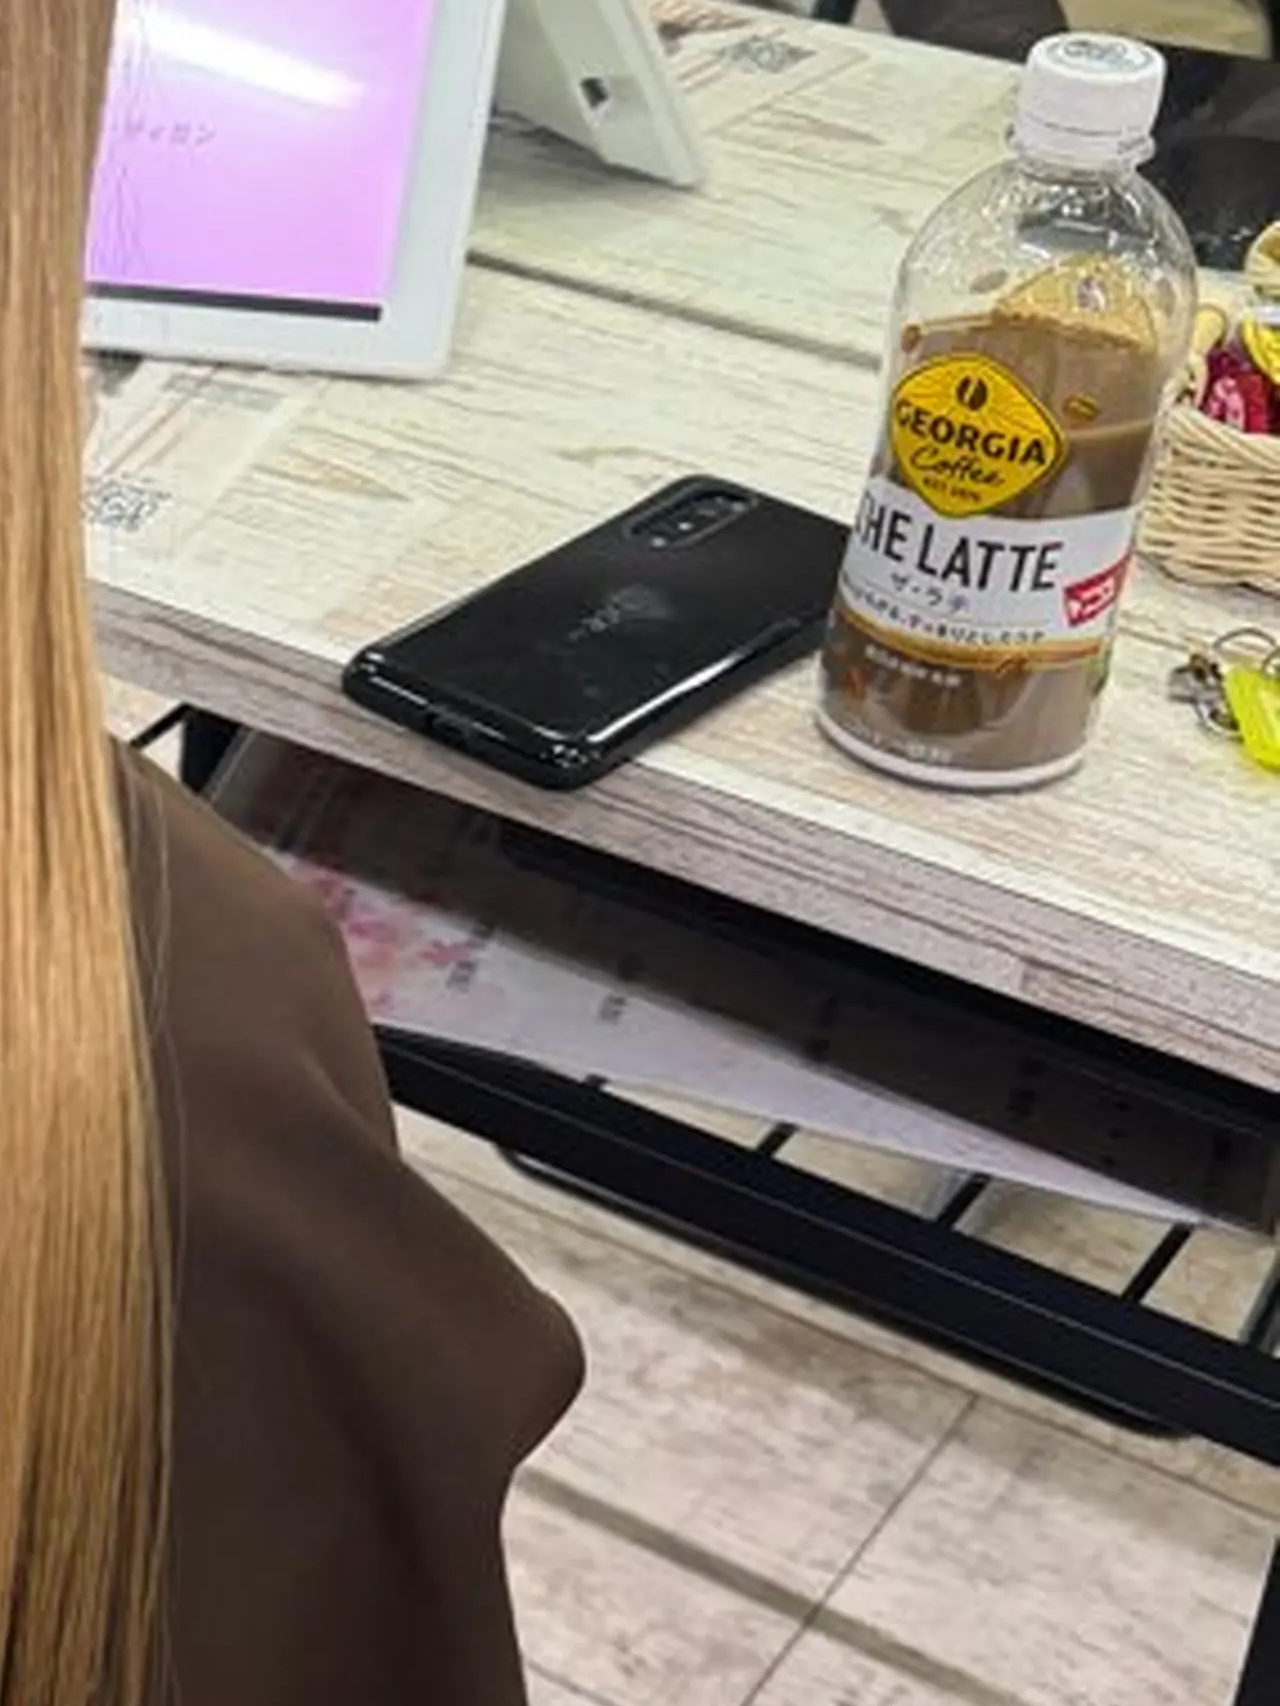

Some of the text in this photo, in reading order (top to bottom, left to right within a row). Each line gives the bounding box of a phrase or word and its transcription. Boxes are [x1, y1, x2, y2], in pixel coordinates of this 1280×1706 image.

[894, 397, 1047, 466] GEORGIA
[908, 446, 1006, 487] Coffee
[915, 523, 1065, 592] LATTE
